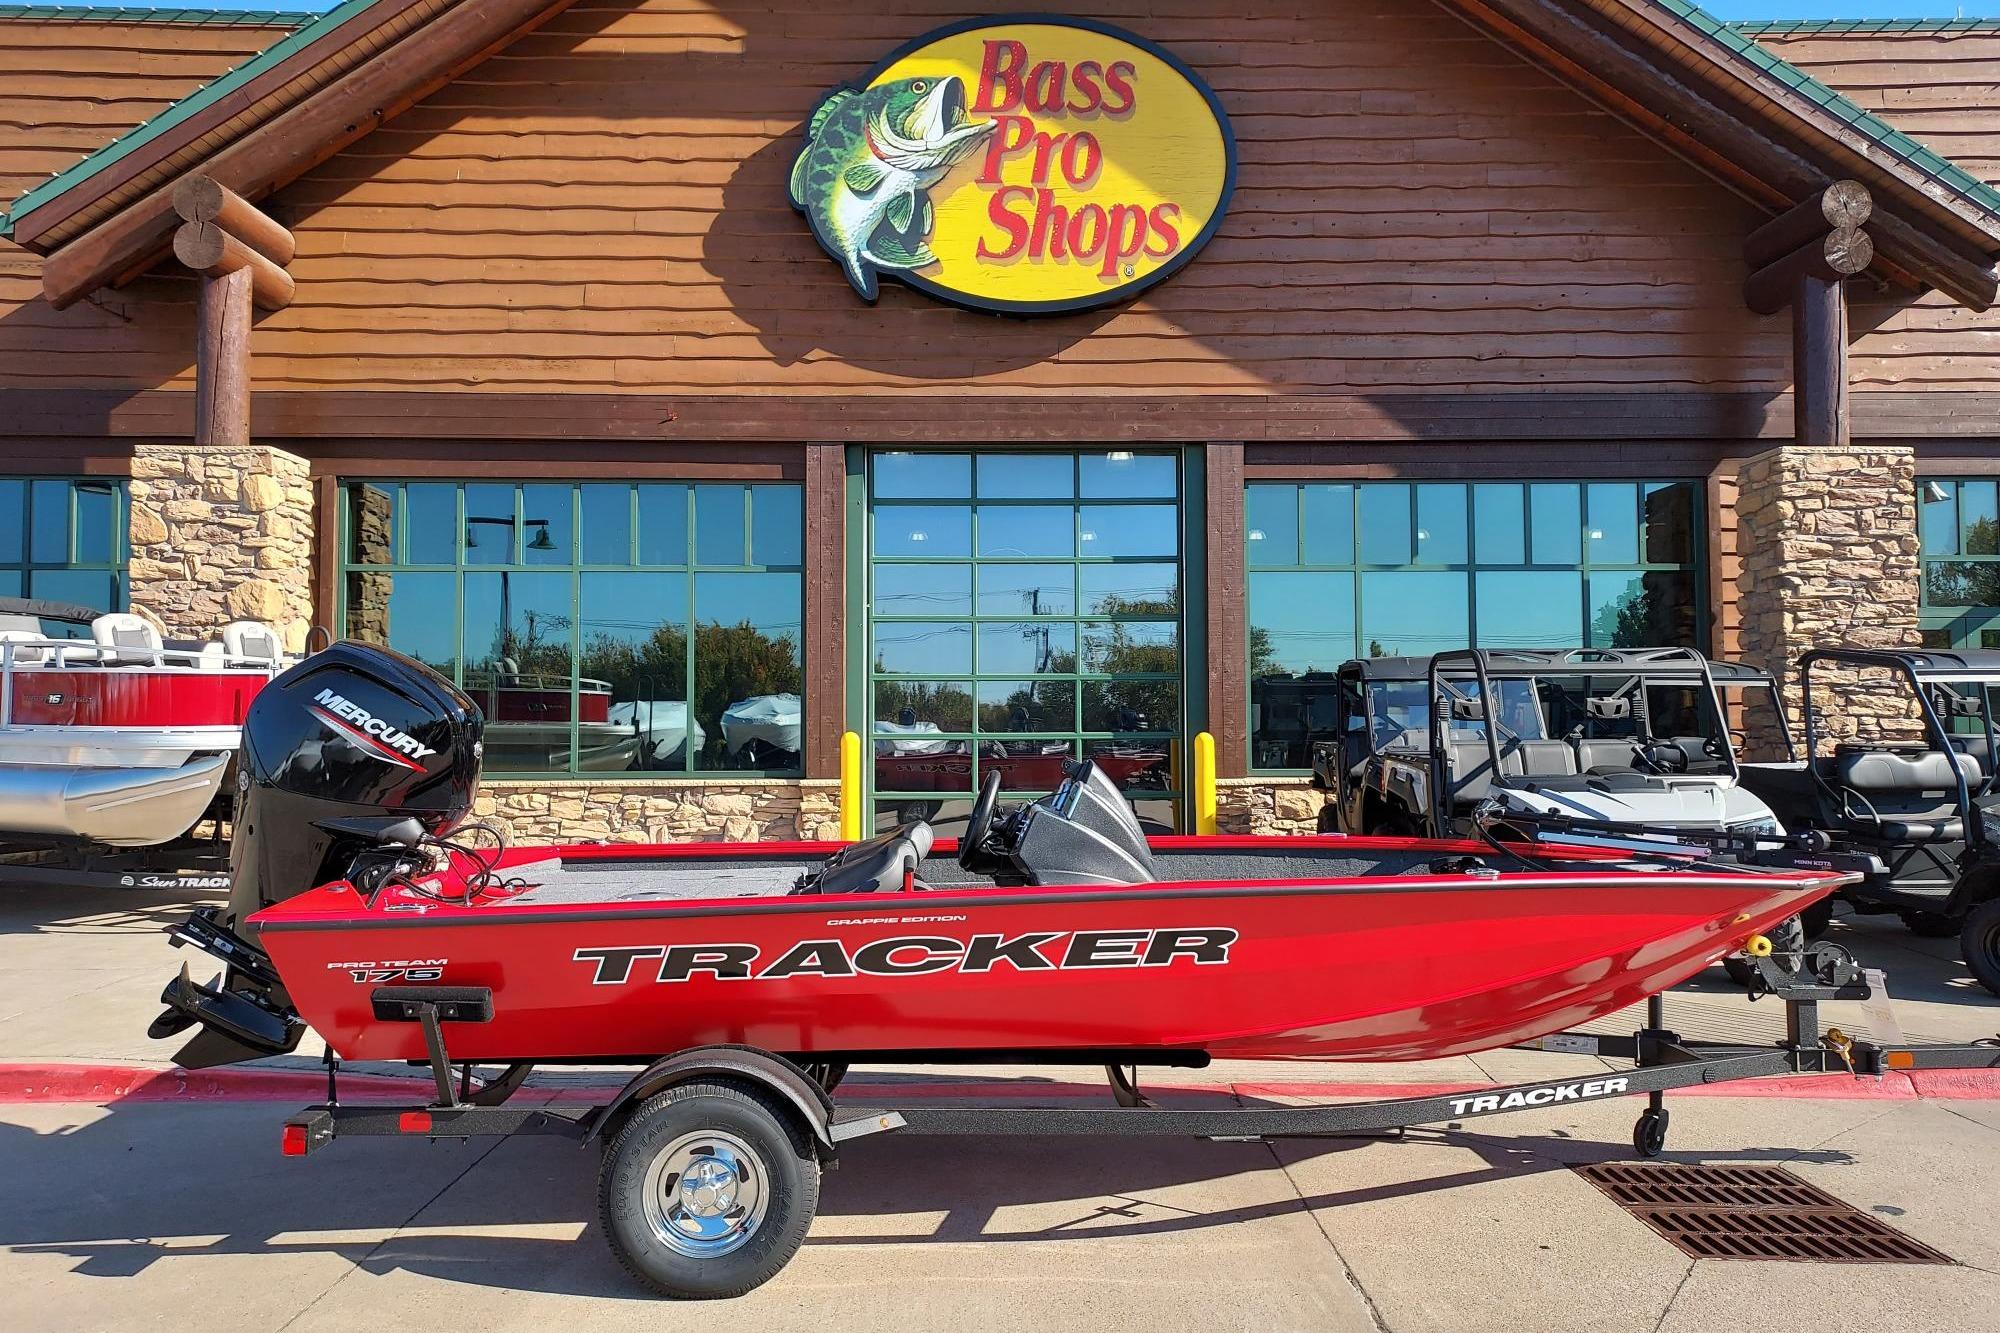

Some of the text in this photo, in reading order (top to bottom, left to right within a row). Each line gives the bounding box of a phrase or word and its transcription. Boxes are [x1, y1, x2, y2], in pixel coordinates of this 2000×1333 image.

[971, 39, 1136, 114] Bass
[975, 115, 1102, 185] Pro
[976, 186, 1181, 278] Shops
[49, 694, 61, 703] 16
[313, 688, 437, 759] MERCURY
[137, 876, 177, 888] Sun
[826, 915, 967, 926] CRAPPIE EDITION
[327, 958, 448, 969] PRO TEAM
[572, 926, 1240, 984] TRACKER
[349, 967, 443, 983] 175
[1450, 1077, 1629, 1115] TRACKER
